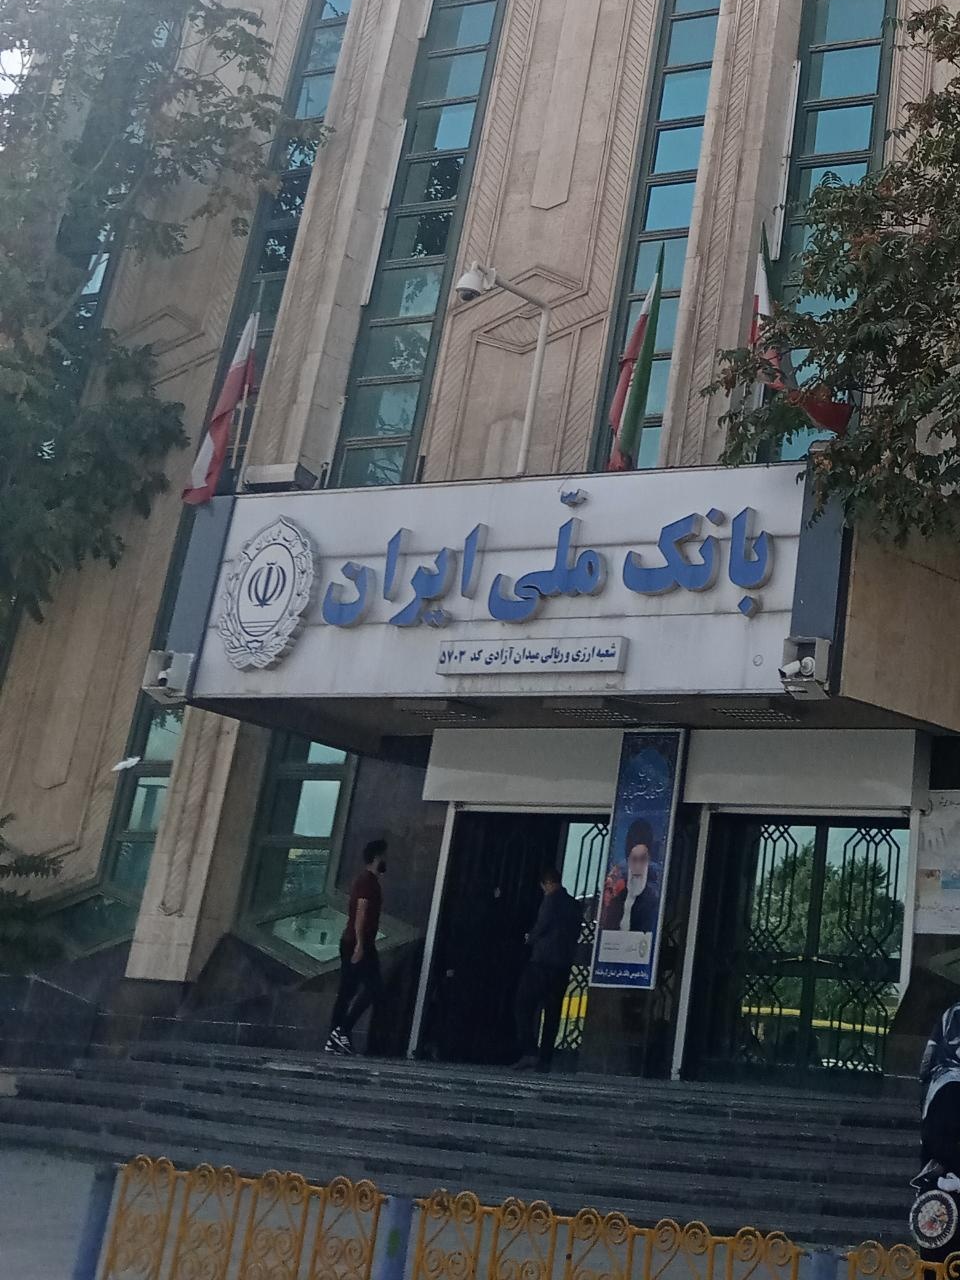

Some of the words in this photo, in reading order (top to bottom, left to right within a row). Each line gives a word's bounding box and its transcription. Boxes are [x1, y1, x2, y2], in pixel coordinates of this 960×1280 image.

[623, 506, 774, 618] بانک
[322, 522, 489, 628] ایران
[470, 648, 483, 663] کد
[485, 646, 514, 666] آزادی
[513, 646, 540, 665] میدان
[571, 645, 596, 663] ارزی
[596, 642, 617, 663] شعبه
